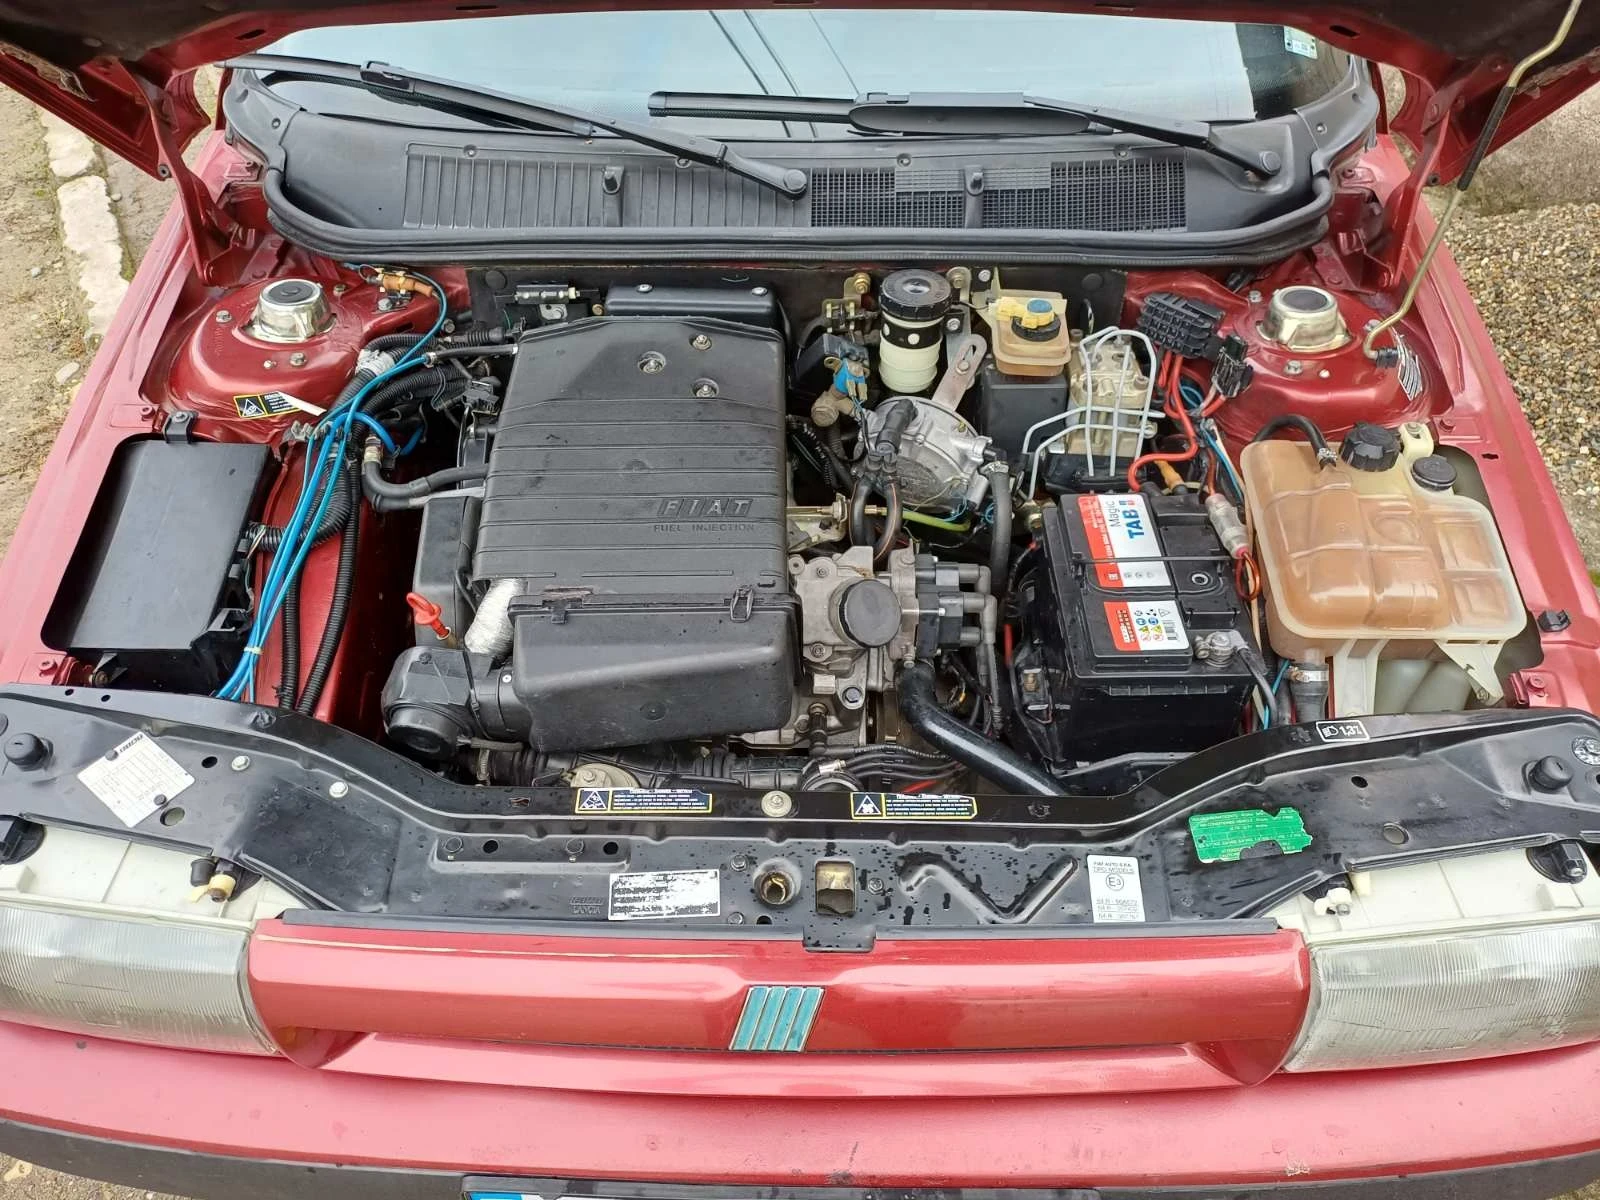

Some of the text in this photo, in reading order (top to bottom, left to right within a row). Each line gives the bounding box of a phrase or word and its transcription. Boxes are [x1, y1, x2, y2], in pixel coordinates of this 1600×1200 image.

[662, 499, 751, 516] FIAT
[1105, 500, 1121, 528] Magic
[654, 523, 754, 532] FUEL INJECTION
[1121, 509, 1144, 539] TAB
